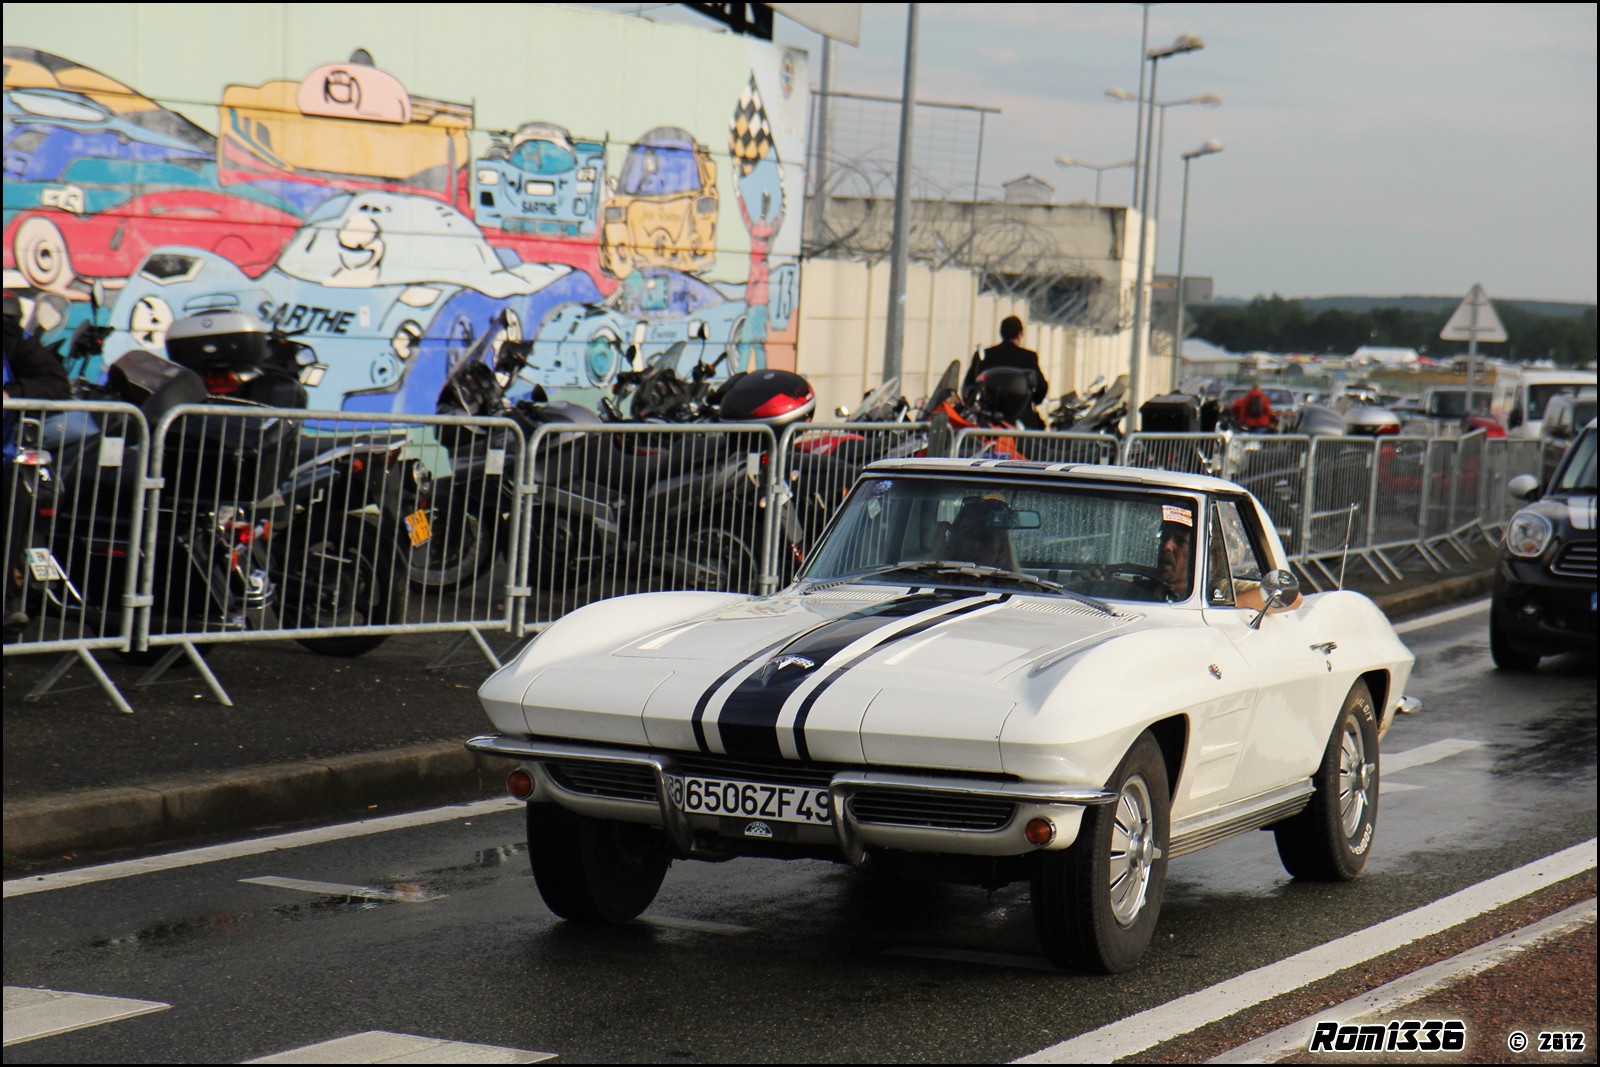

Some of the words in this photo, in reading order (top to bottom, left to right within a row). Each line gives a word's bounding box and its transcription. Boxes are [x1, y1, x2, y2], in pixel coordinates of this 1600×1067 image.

[521, 201, 557, 215] SARTHE
[258, 300, 356, 334] SARTHE
[686, 779, 832, 822] 6506ZF49
